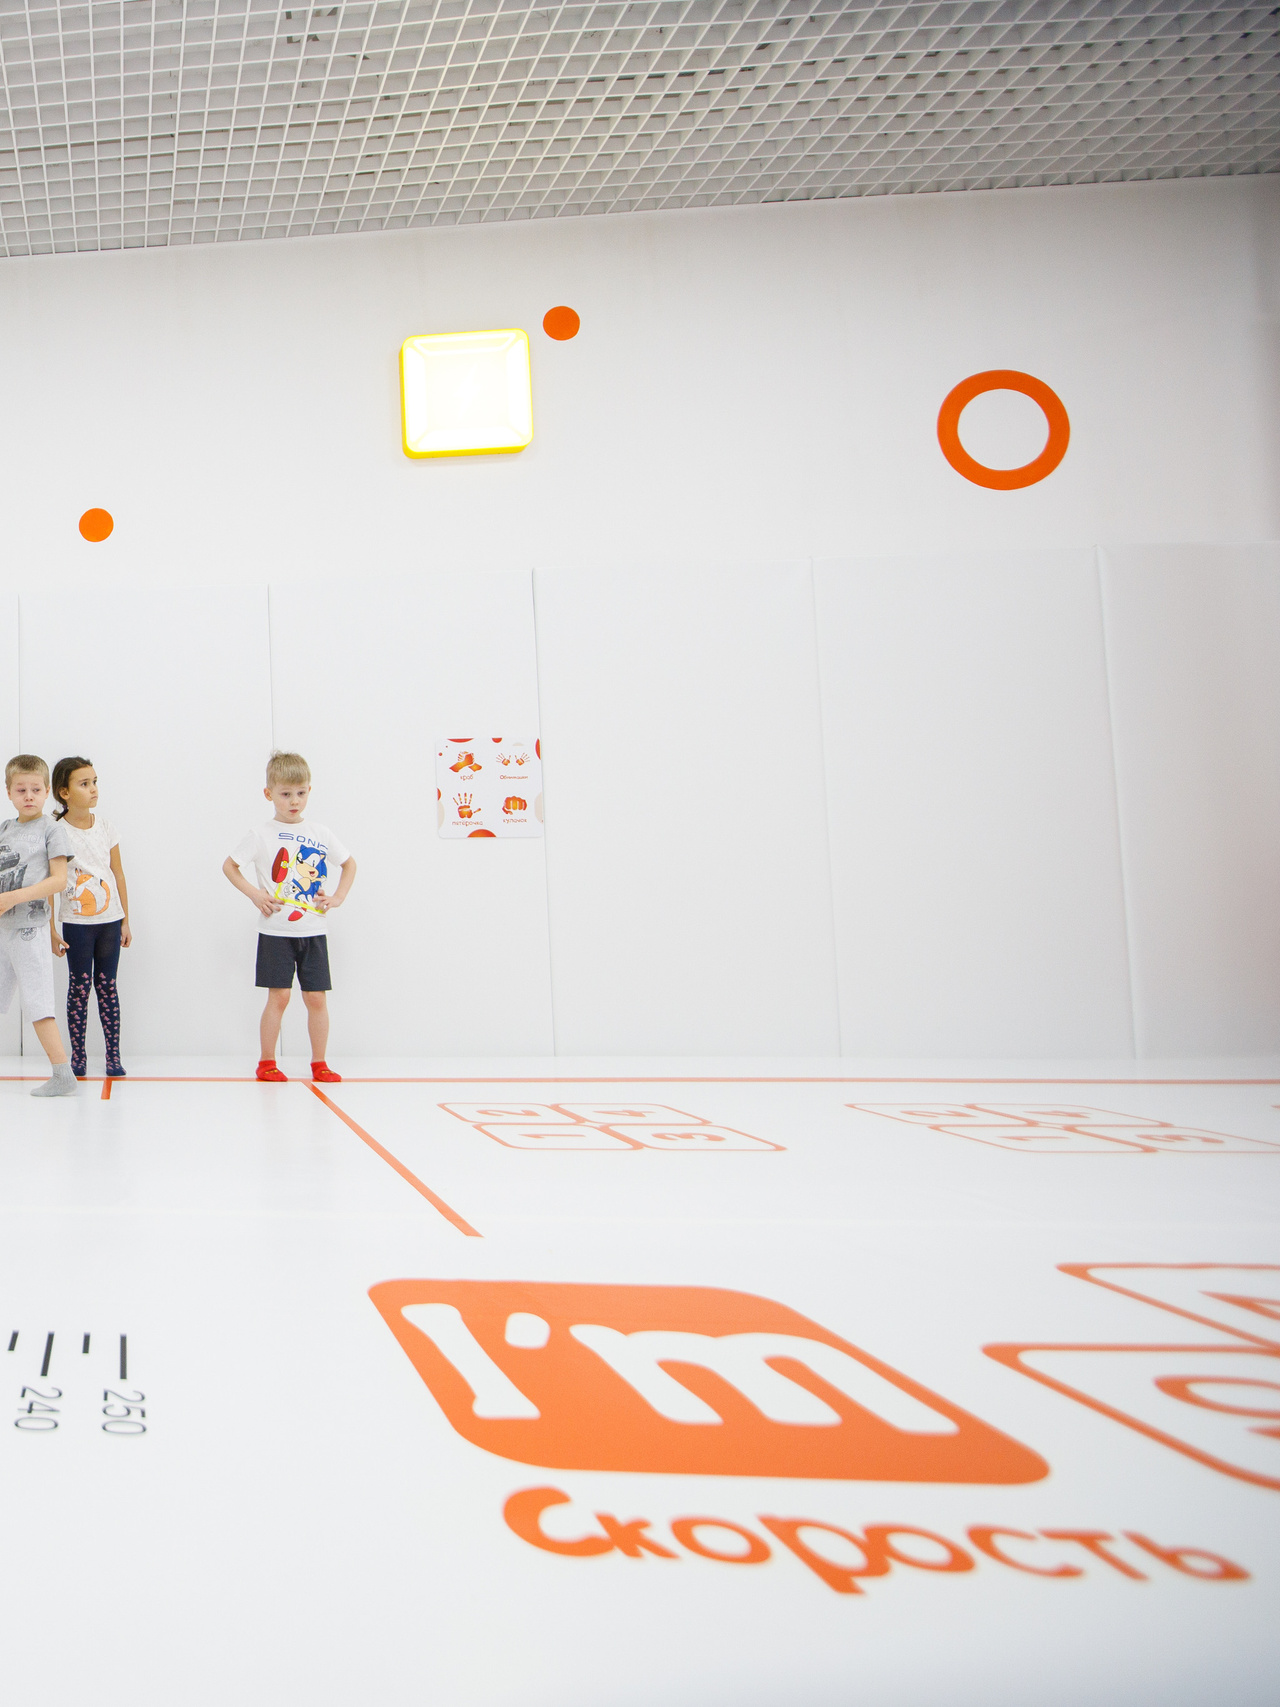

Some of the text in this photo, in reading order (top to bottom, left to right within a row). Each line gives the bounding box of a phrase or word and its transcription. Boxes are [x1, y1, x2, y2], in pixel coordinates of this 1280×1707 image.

[13, 1386, 63, 1432] 240
[101, 1389, 147, 1436] 250
[502, 1486, 1251, 1597] Скорость
